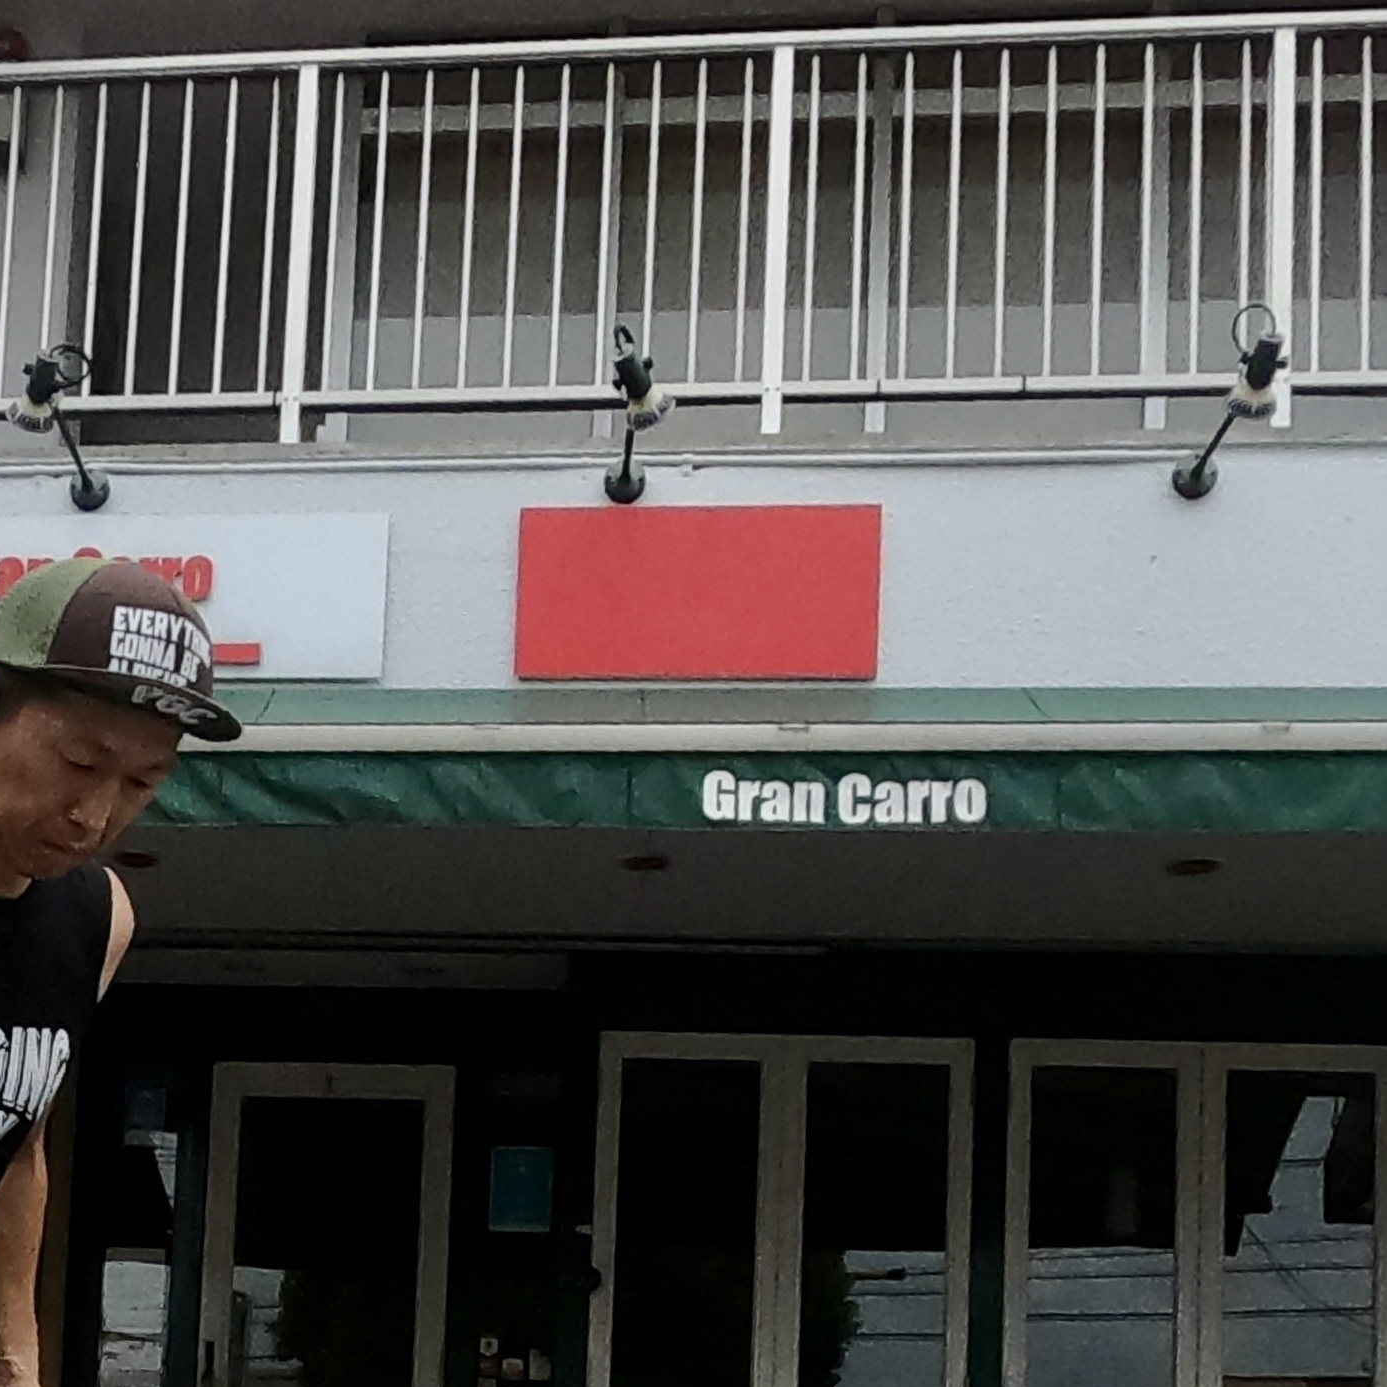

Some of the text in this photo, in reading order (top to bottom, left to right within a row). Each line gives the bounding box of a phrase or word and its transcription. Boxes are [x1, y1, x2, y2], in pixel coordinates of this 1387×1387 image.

[110, 630, 202, 683] GONNA BE
[702, 769, 987, 824] Gran Carro
